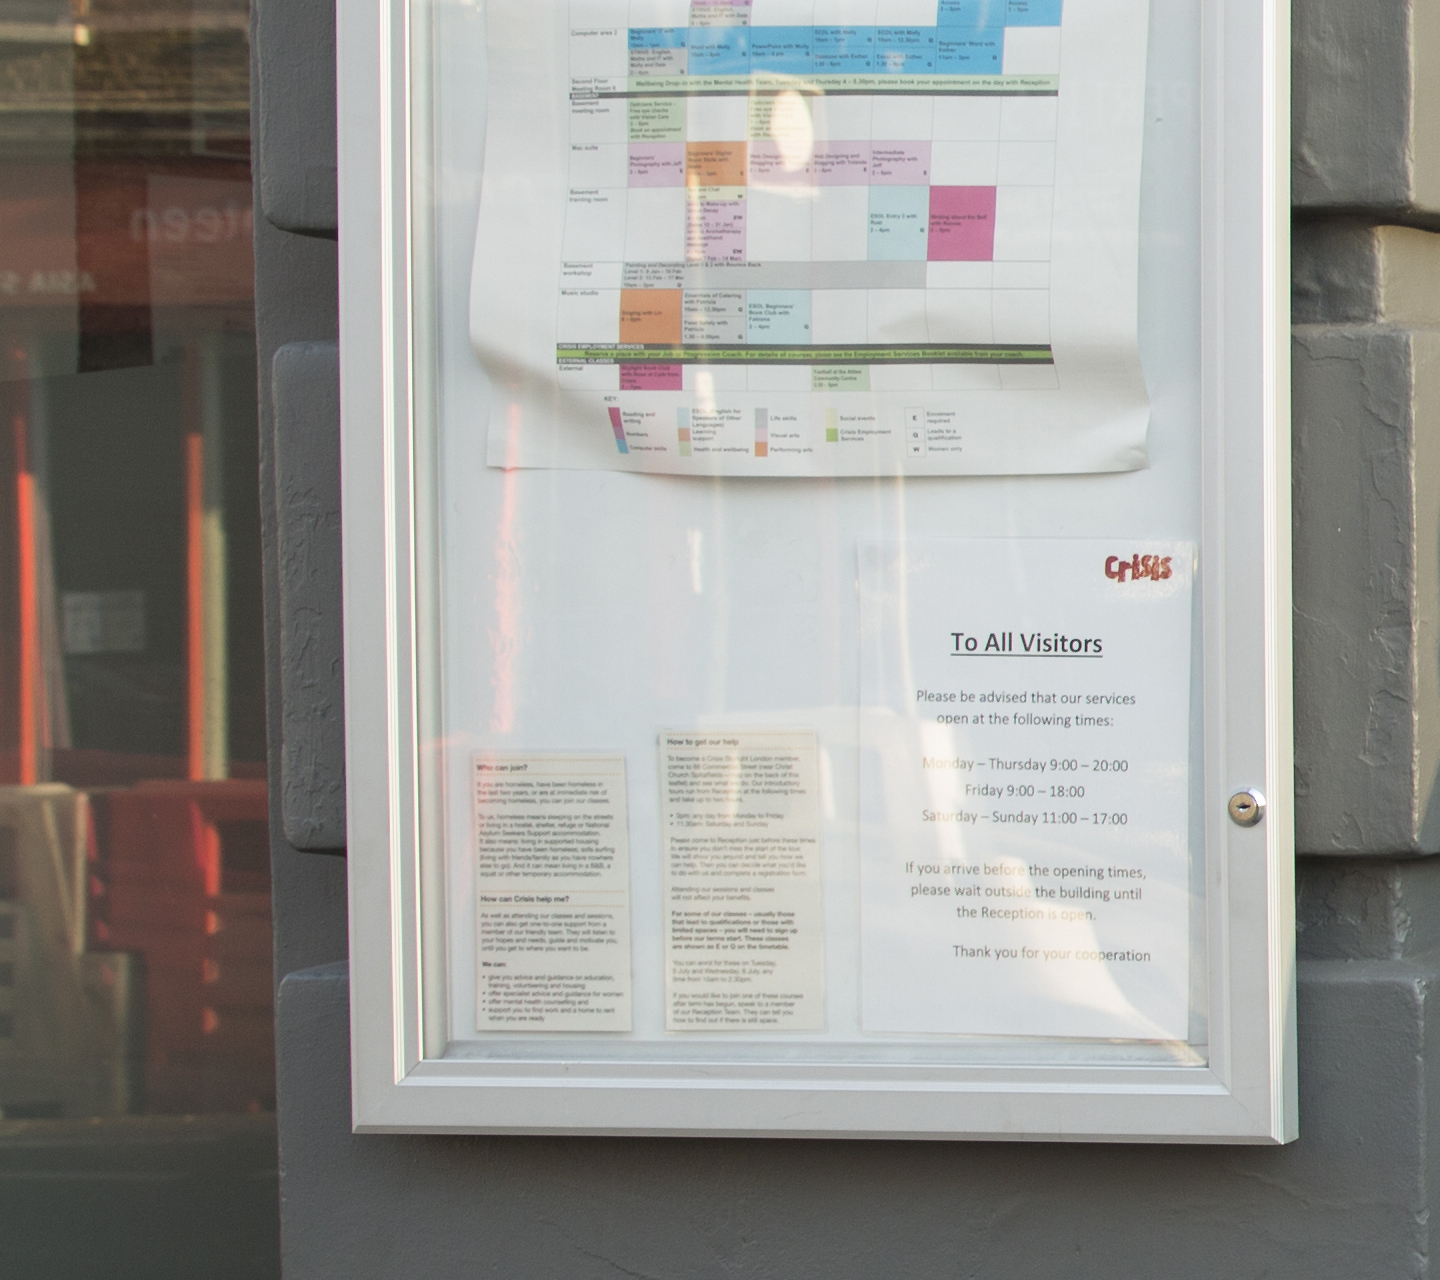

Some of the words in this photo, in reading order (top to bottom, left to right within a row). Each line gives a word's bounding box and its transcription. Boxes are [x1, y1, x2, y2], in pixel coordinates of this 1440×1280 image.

[951, 632, 978, 652] To
[984, 632, 1013, 652] All
[1020, 632, 1103, 653] Visitors
[917, 690, 956, 703] Please
[961, 691, 975, 703] be
[980, 691, 1027, 703] advised
[1032, 692, 1056, 703] that
[1061, 694, 1082, 703] our
[1086, 694, 1135, 704] services
[937, 714, 968, 725] open
[973, 714, 984, 725] at
[989, 713, 1009, 725] the
[1014, 713, 1071, 728] following
[1076, 715, 1113, 726] times:
[667, 738, 684, 746] How
[695, 739, 707, 747] get
[724, 739, 739, 747] help
[510, 764, 528, 773] join?
[923, 757, 974, 771] Monday
[989, 758, 1046, 772] Thursday
[1050, 759, 1077, 771] 9:00
[1093, 760, 1128, 772] 20:00
[966, 784, 1003, 798] Friday
[1007, 785, 1034, 796] 9:00
[1051, 786, 1085, 797] 18:00
[923, 810, 977, 824] Saturday
[993, 811, 1038, 825] Sunday
[1043, 812, 1077, 824] 11:00
[1094, 812, 1127, 825] 17:00
[906, 861, 914, 878] If
[917, 865, 940, 878] you
[944, 865, 979, 878] arrive
[984, 863, 1025, 876] before
[1029, 864, 1049, 878] the
[1054, 865, 1104, 880] opening
[1108, 865, 1146, 879] times,
[514, 895, 534, 903] Crisis
[536, 895, 552, 905] help
[553, 895, 570, 903] me?
[911, 884, 950, 899] please
[955, 885, 980, 899] wait
[985, 887, 1030, 899] outside
[1035, 886, 1055, 899] the
[1060, 886, 1110, 902] building
[1114, 887, 1141, 899] until
[957, 906, 977, 919] the
[982, 907, 1043, 920] Reception
[1047, 908, 1057, 919] is
[1061, 911, 1097, 922] open.
[953, 945, 991, 958] Thank
[995, 948, 1017, 961] you
[1022, 946, 1039, 961] for
[1043, 948, 1071, 961] your
[1077, 948, 1150, 961] cooperation
